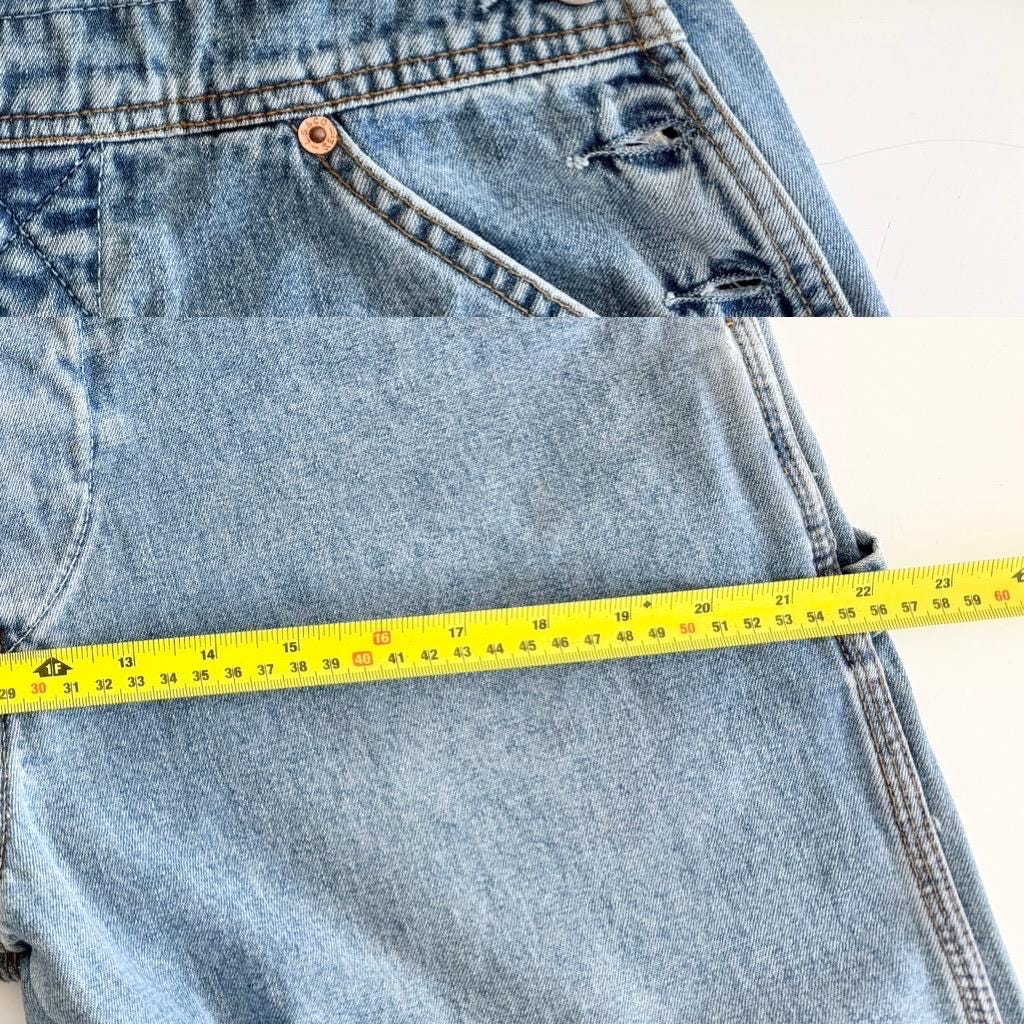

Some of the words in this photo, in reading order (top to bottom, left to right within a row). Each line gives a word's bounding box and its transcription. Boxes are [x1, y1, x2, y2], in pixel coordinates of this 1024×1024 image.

[31, 683, 46, 693] 30
[193, 671, 209, 681] 35
[355, 653, 371, 664] 40
[519, 641, 536, 651] 45
[680, 623, 695, 634] 50
[712, 621, 728, 632] 51
[744, 618, 761, 629] 52
[775, 615, 792, 625] 53
[807, 611, 824, 622] 54
[839, 608, 856, 619] 55
[870, 605, 887, 615] 56
[902, 602, 917, 612] 57
[933, 598, 950, 609] 58
[964, 595, 981, 606] 59
[995, 590, 1009, 601] 60
[119, 658, 133, 668] 13
[201, 650, 215, 660] 14
[283, 643, 297, 653] 15
[374, 633, 389, 643] 16
[449, 628, 463, 638] 17
[532, 620, 547, 630] 18
[615, 612, 629, 621] 19
[695, 603, 710, 613] 20
[776, 594, 790, 605] 21
[856, 587, 871, 597] 22
[935, 579, 950, 589] 23
